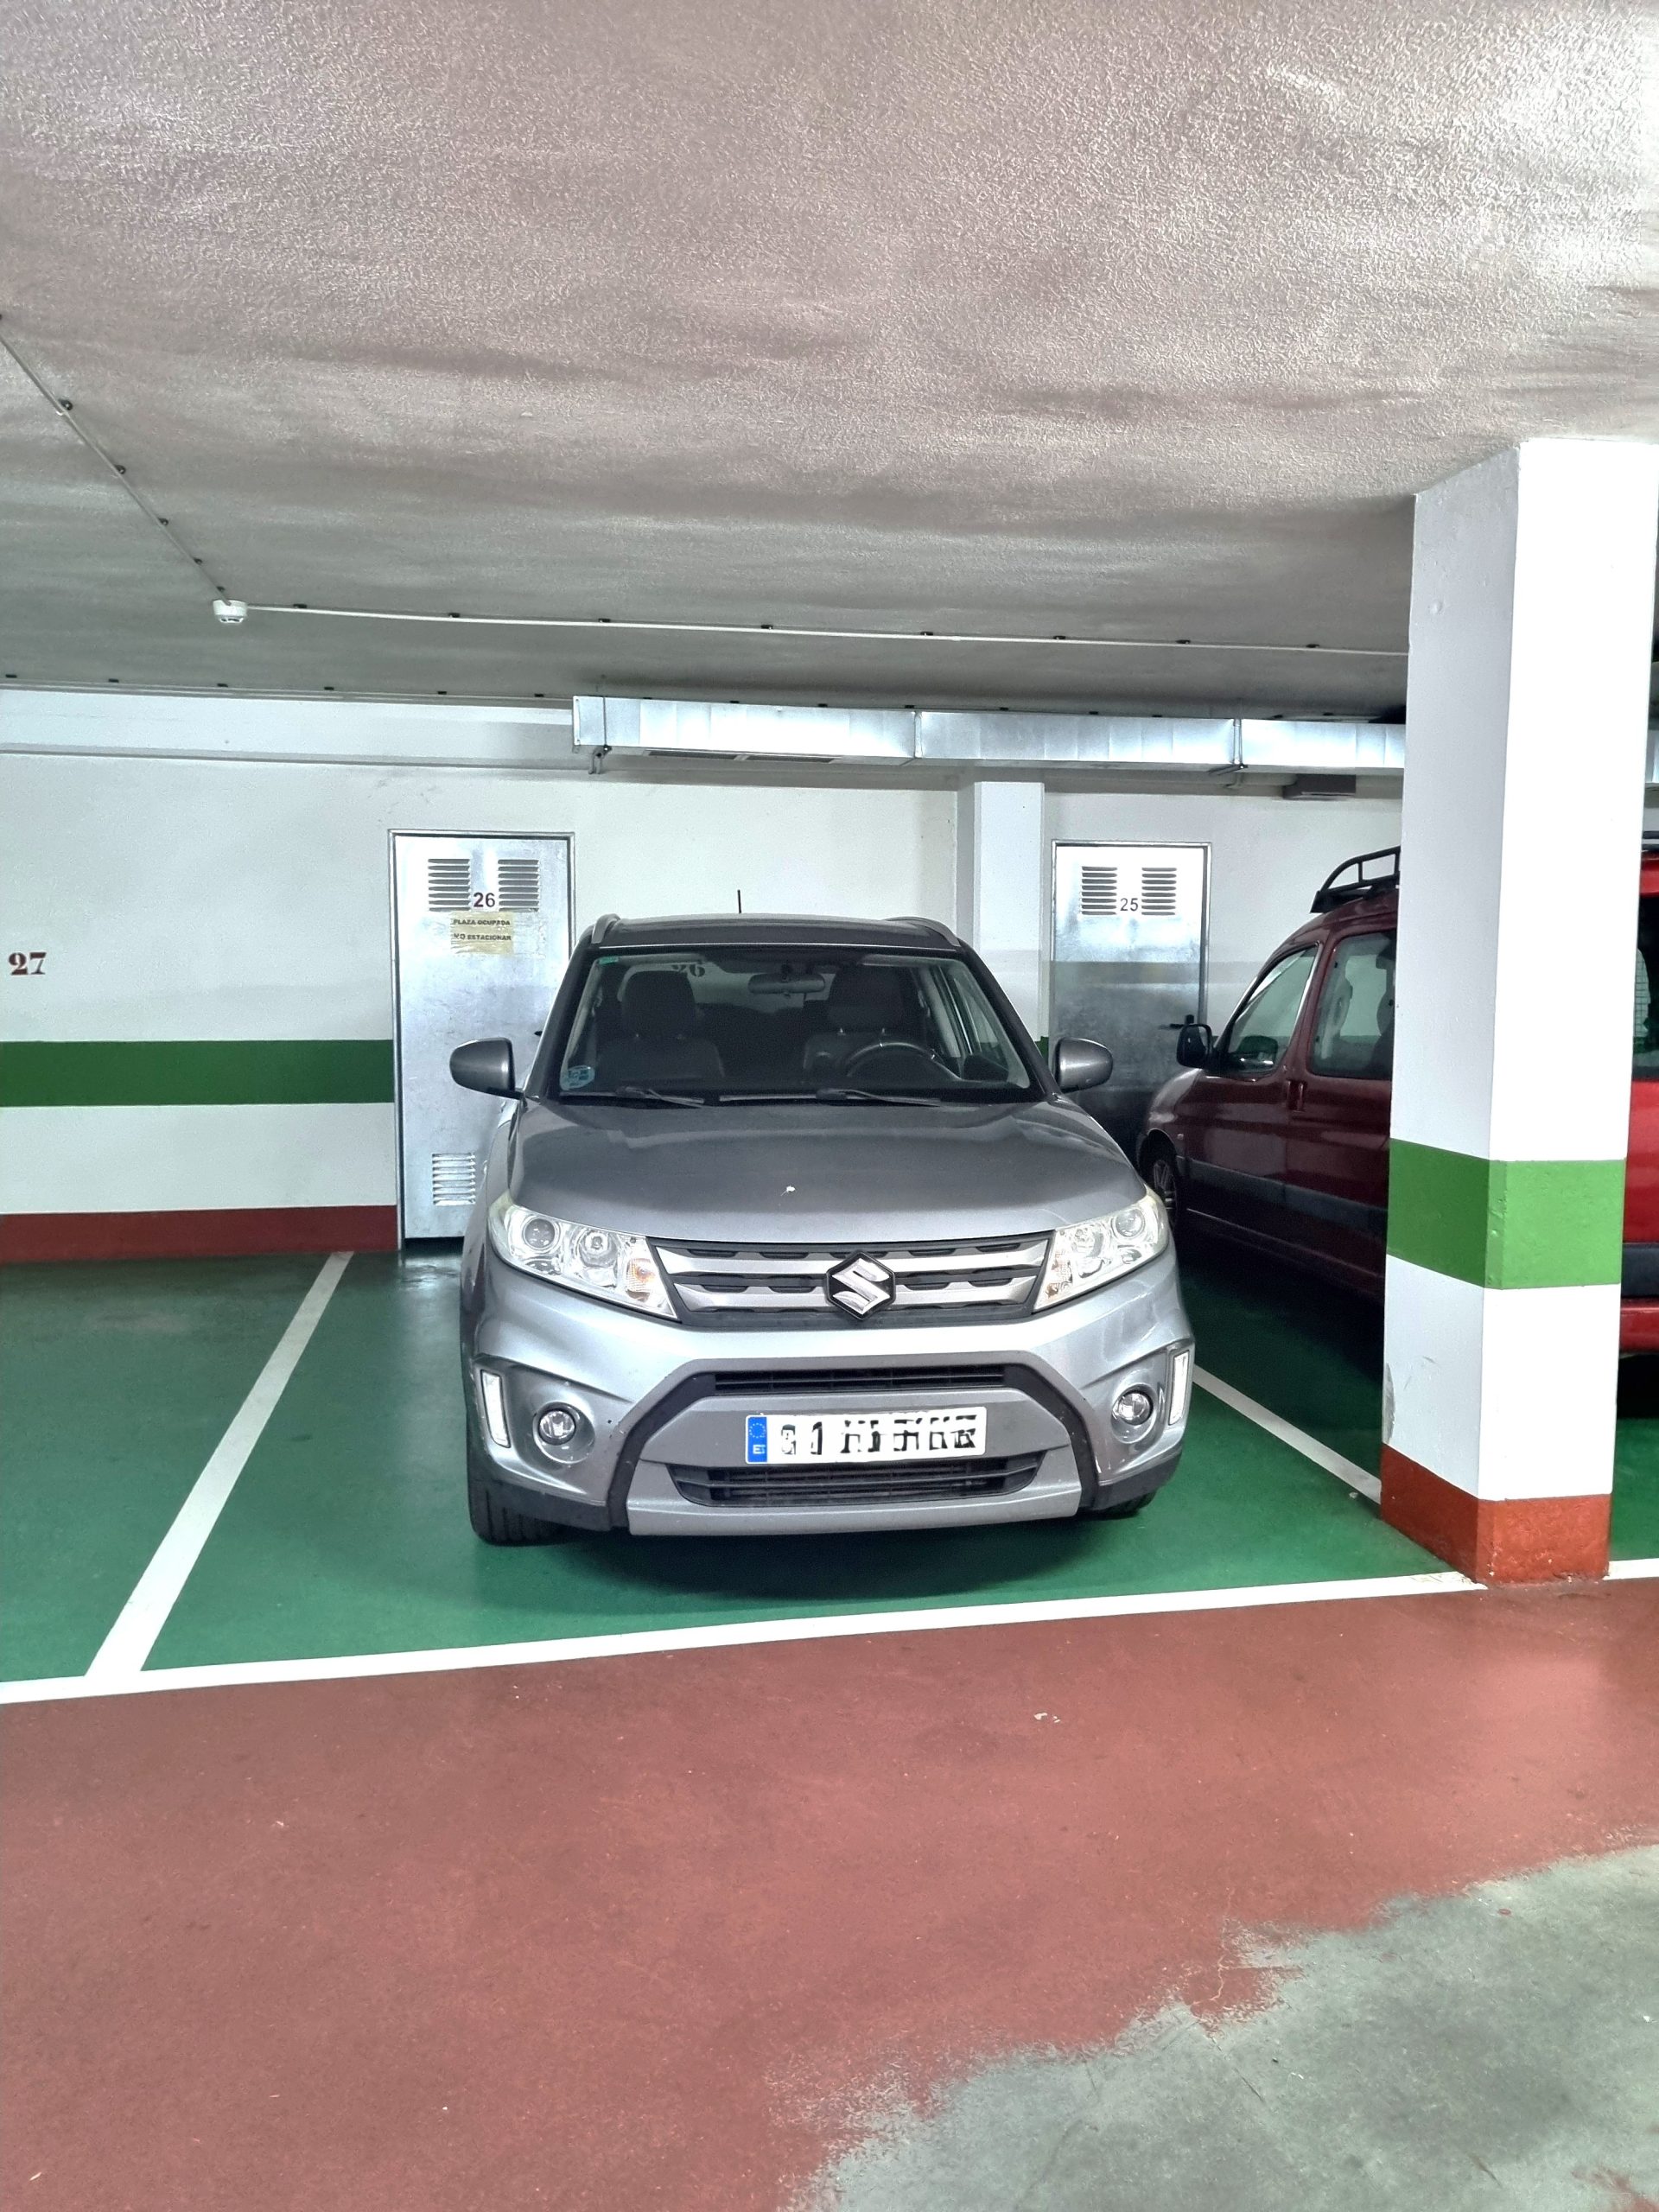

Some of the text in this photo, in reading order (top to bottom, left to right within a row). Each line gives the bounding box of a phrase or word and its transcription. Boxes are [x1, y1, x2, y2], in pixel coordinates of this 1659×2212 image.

[473, 892, 496, 908] 26
[1120, 897, 1139, 912] 25
[8, 951, 48, 976] 27
